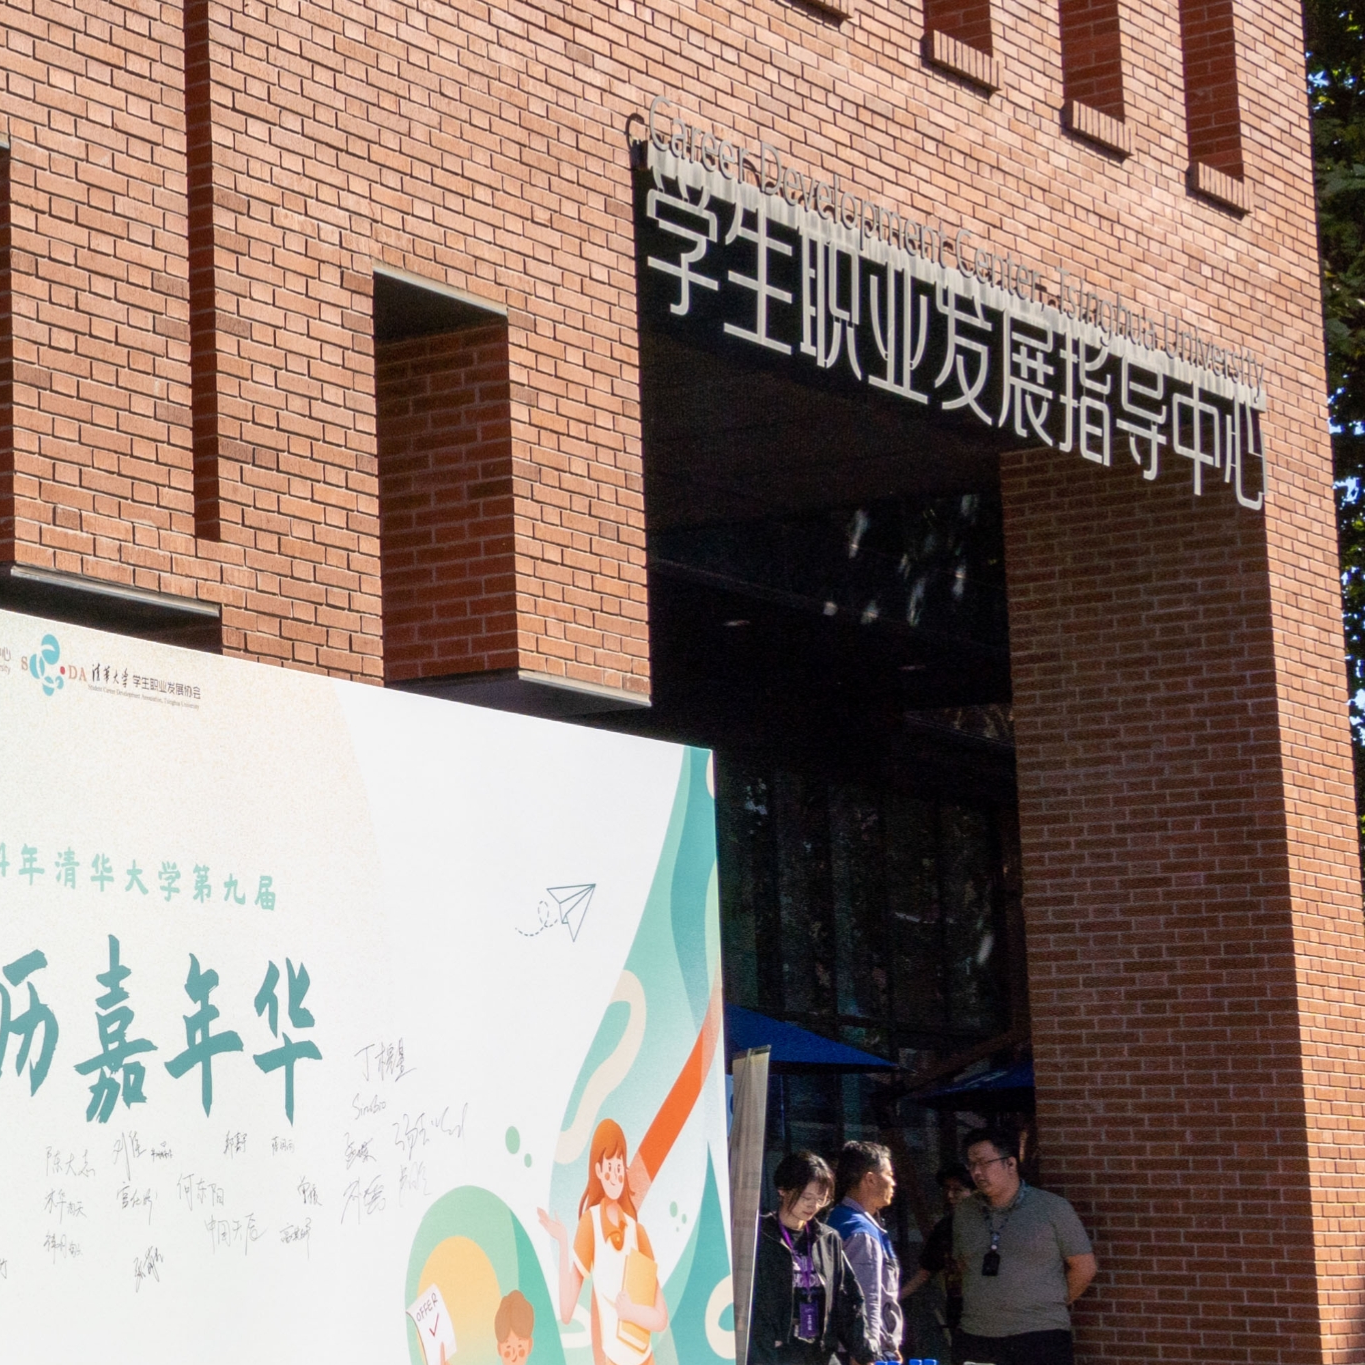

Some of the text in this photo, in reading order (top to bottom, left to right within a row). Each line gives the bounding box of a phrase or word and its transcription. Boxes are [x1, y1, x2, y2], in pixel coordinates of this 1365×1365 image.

[646, 166, 1269, 511] 学生职业发展指导中心
[649, 95, 749, 184] Career
[760, 141, 948, 269] Development
[1056, 267, 1158, 351] Tsinghua
[1163, 312, 1265, 404] University
[416, 1292, 438, 1322] OFFER
